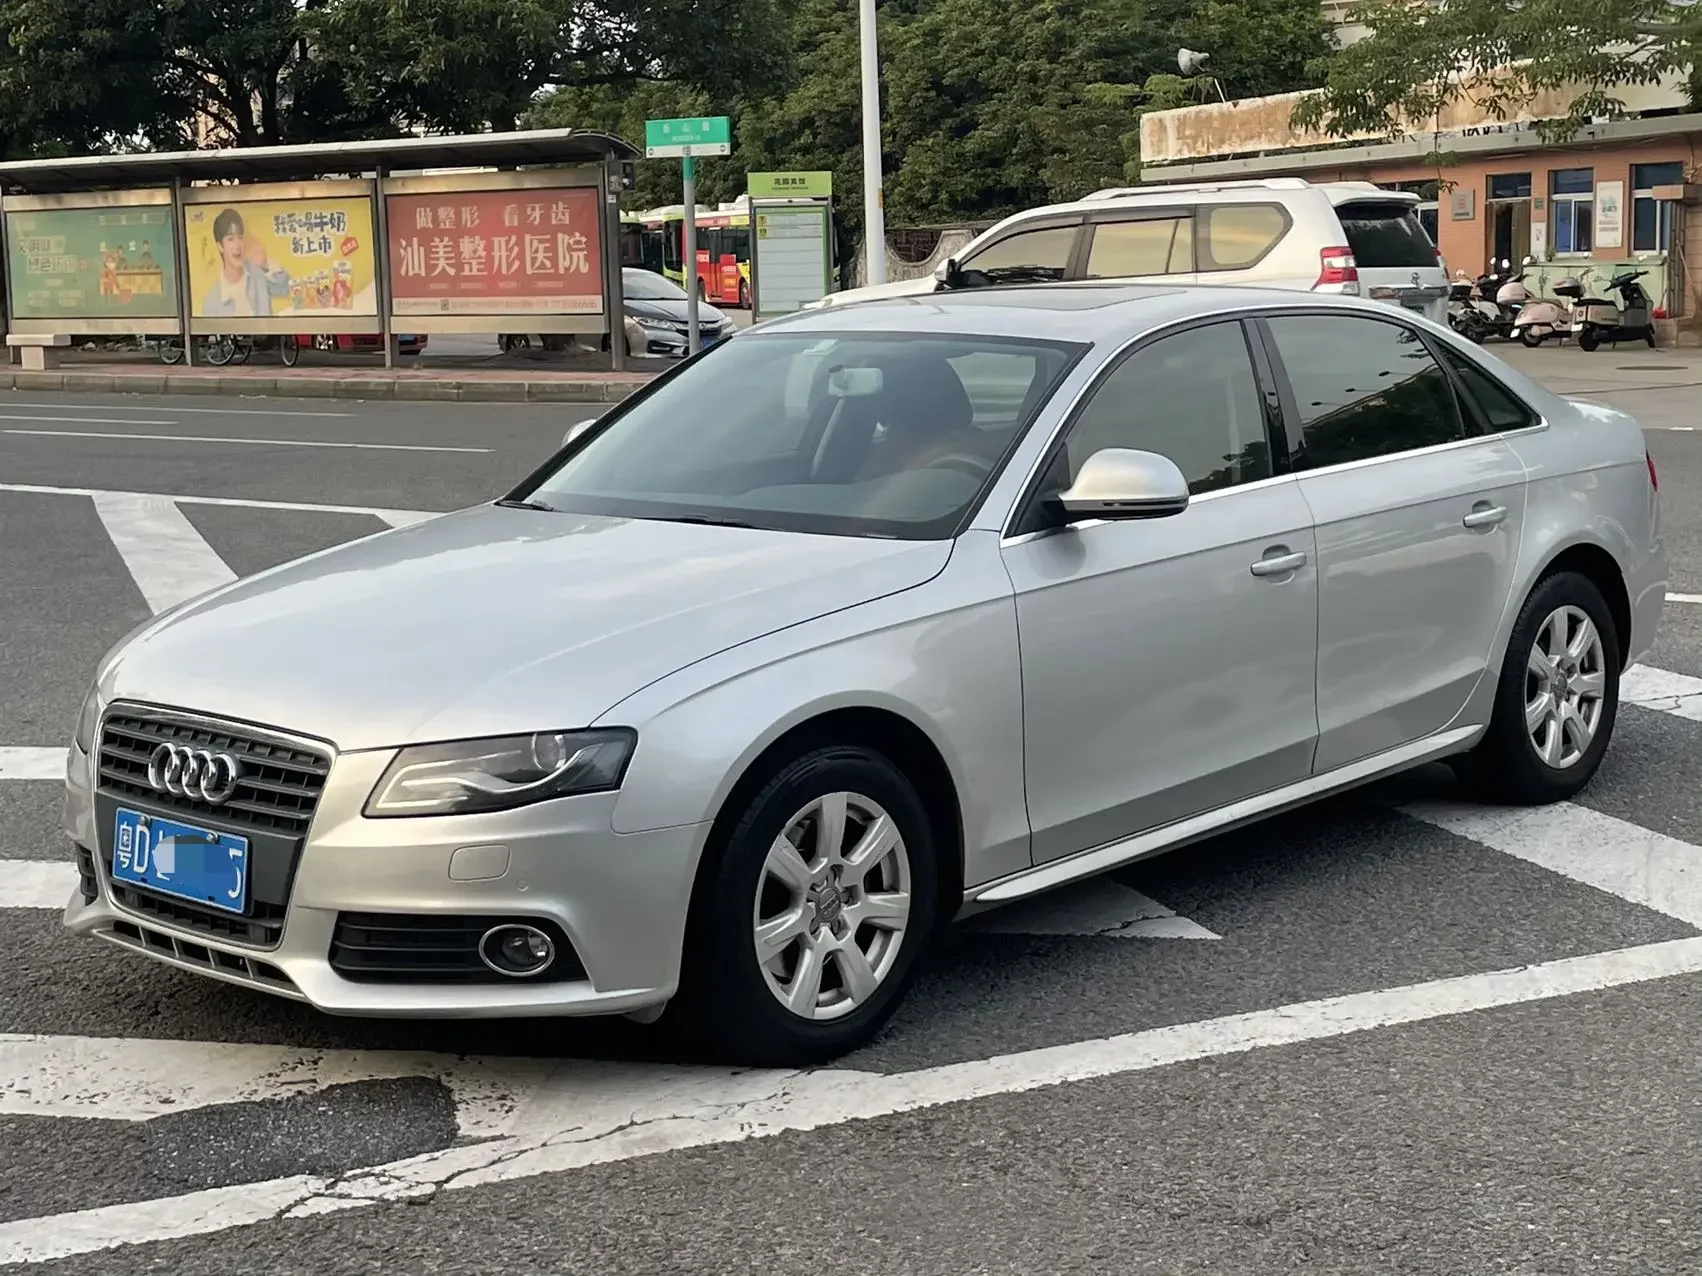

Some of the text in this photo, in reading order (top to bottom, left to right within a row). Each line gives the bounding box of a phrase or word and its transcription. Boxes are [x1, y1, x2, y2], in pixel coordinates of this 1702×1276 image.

[416, 201, 570, 230] 做整形 看牙齿
[292, 235, 332, 255] 新上市
[400, 231, 589, 277] 汕美整形医院
